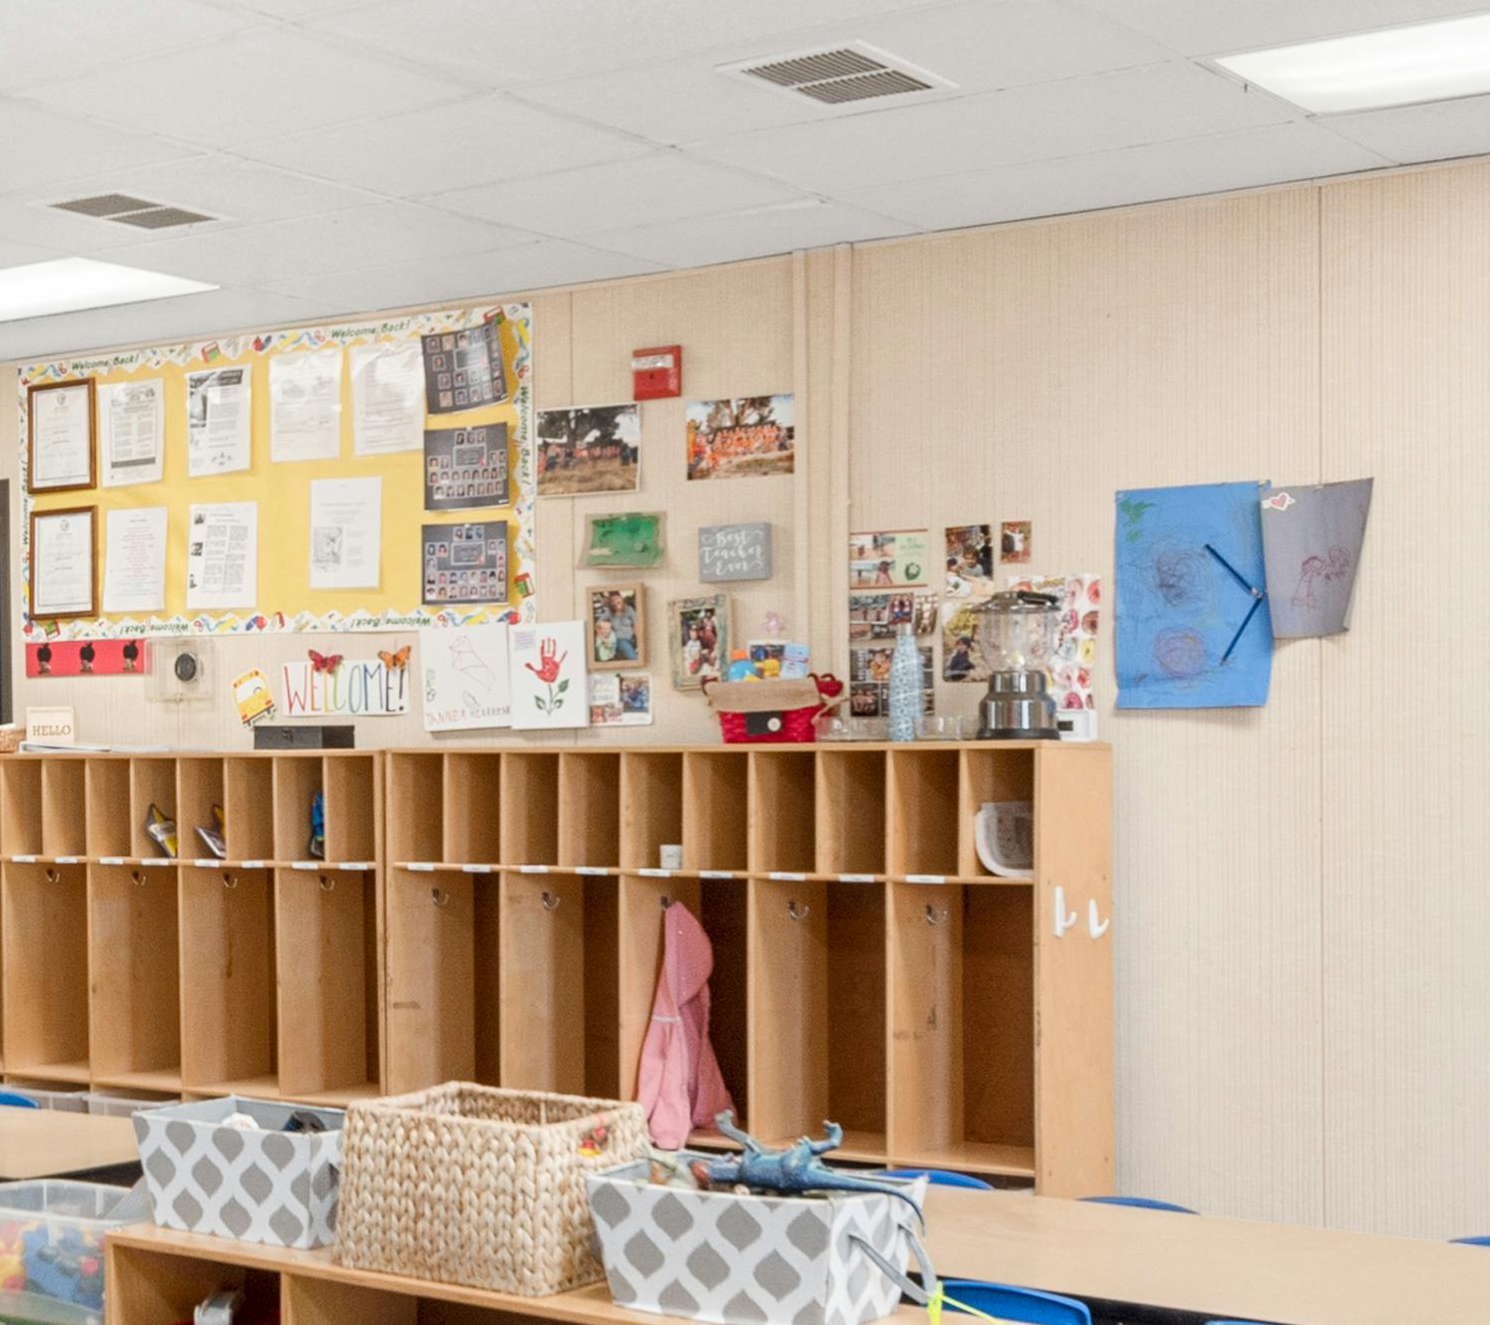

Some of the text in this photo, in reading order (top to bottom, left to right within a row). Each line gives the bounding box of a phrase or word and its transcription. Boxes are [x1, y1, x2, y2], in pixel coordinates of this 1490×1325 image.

[331, 319, 411, 339] Welcome Back!
[71, 353, 140, 372] Welcome Back!
[520, 385, 530, 444] Welcome
[350, 616, 431, 630] Welcome Back!
[283, 662, 407, 714] WELCOME!
[32, 724, 72, 737] HELLO
